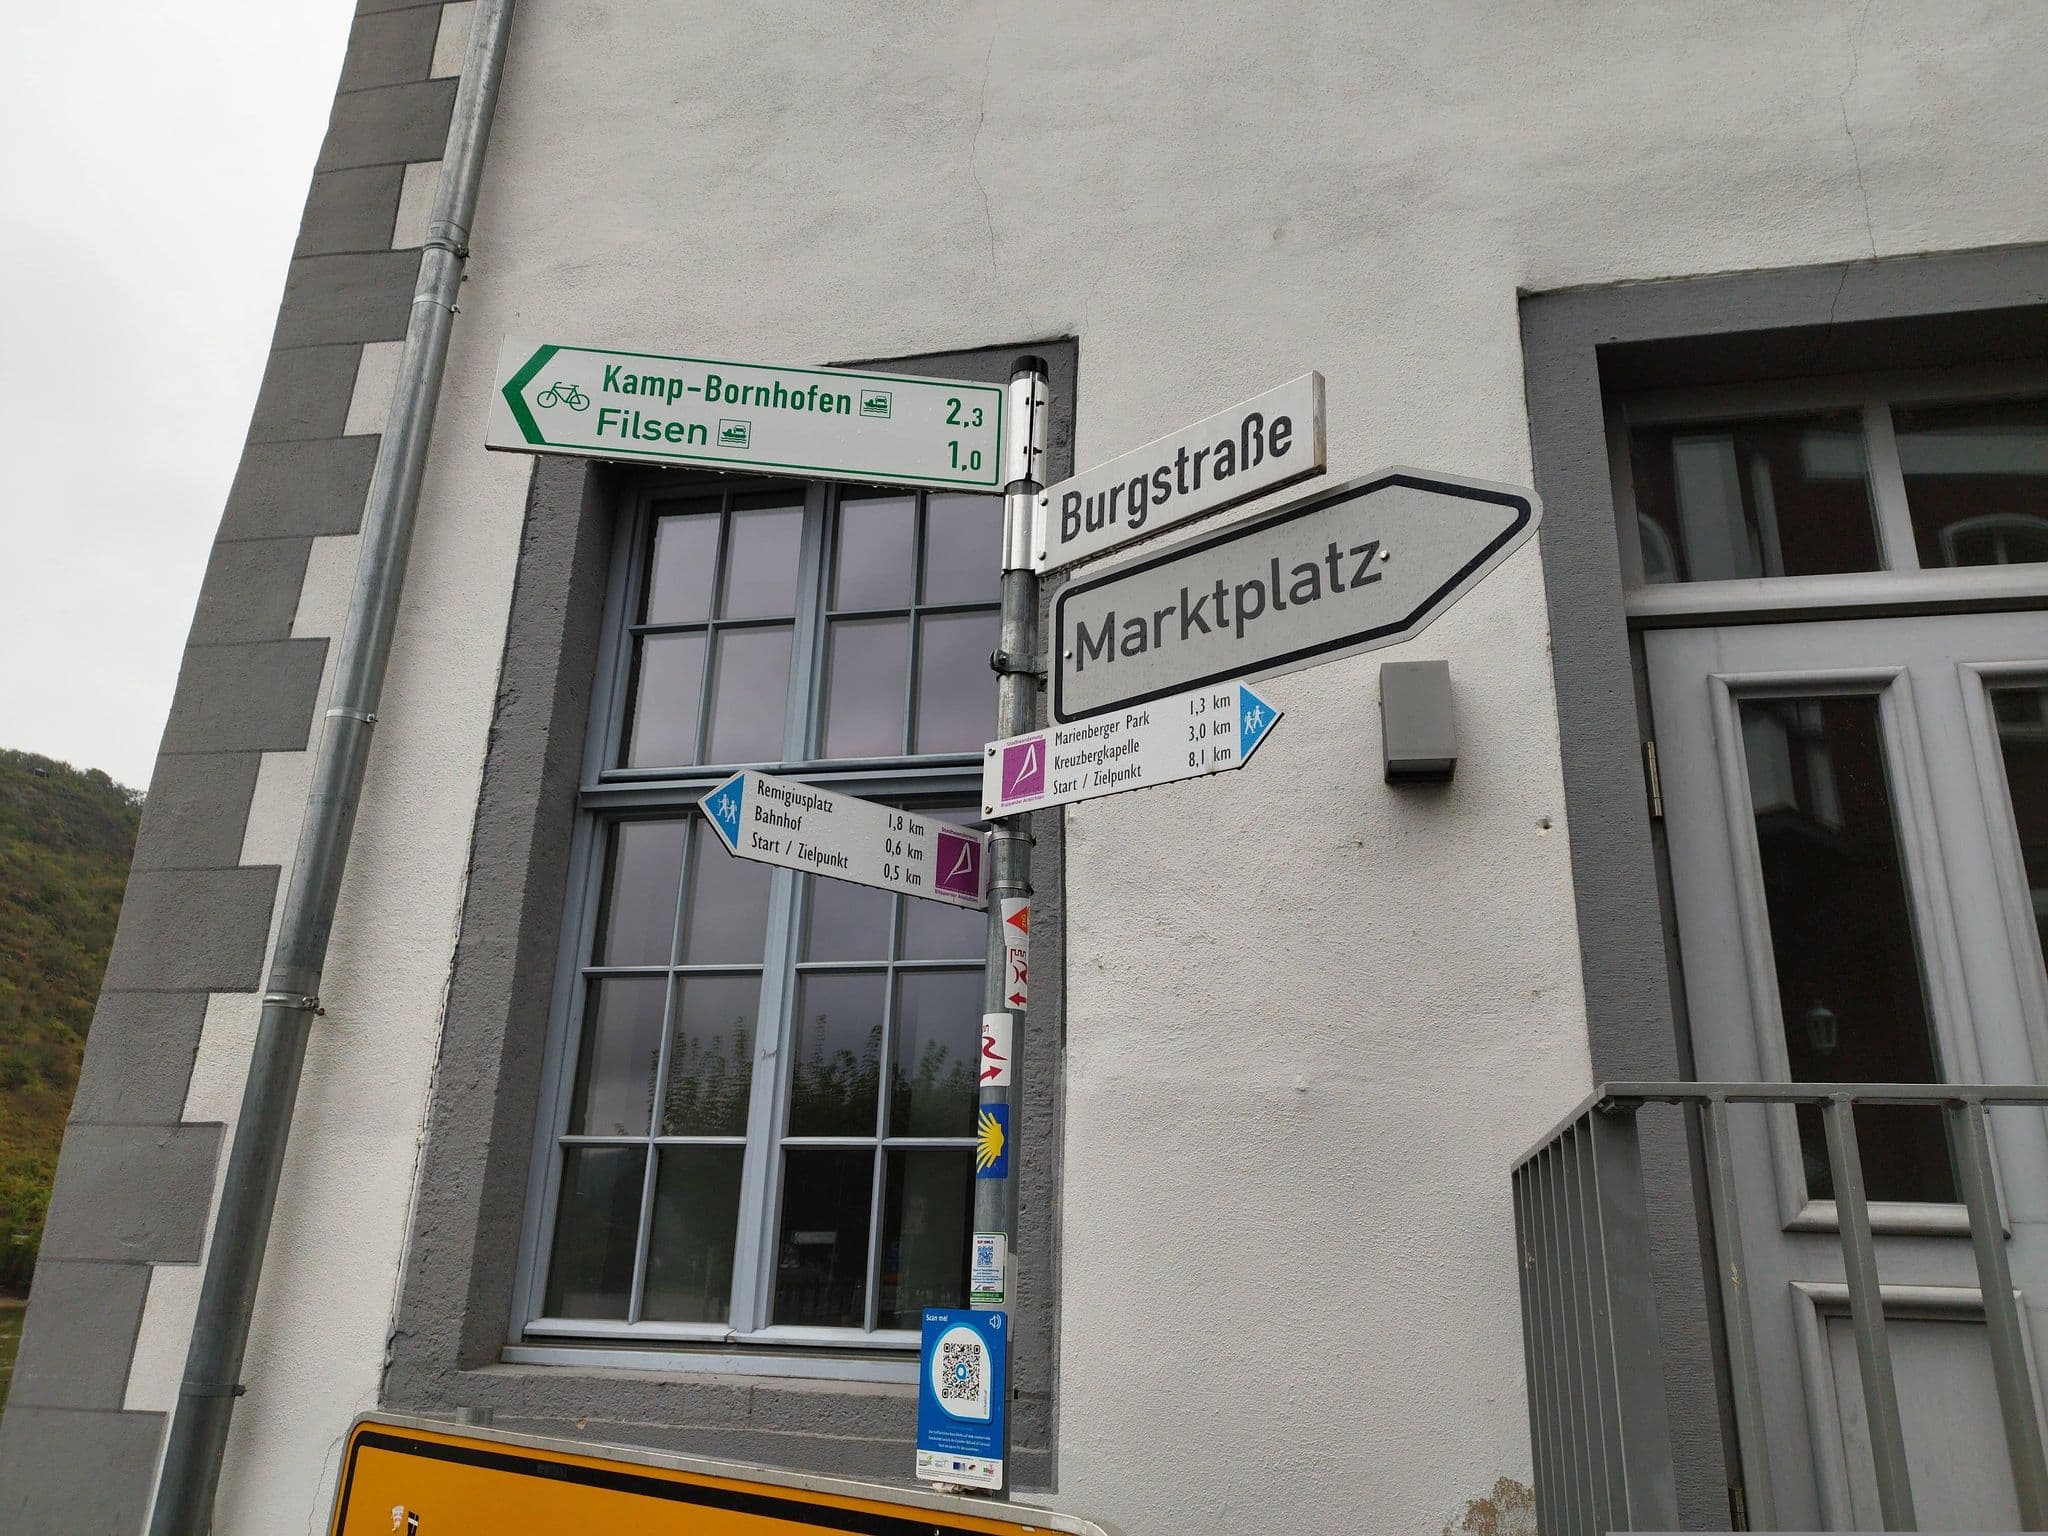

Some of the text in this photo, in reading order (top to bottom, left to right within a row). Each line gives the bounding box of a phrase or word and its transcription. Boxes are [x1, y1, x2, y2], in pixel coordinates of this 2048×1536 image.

[601, 364, 852, 415] Kamp-Bornhofen
[596, 407, 709, 446] Filsen
[945, 397, 984, 428] 2,3
[947, 440, 982, 472] 1,0
[1060, 411, 1294, 544] Burgstraße
[1074, 539, 1382, 672] Marktplatz
[1189, 694, 1231, 717] 1,3 km
[1054, 710, 1150, 747] Marienberger Park
[1188, 720, 1232, 744] 3,0 km
[1054, 739, 1140, 771] Kreuzbergkapelle
[1188, 746, 1232, 769] 8,1 km
[1052, 763, 1142, 796] Start / Zielpunkt
[756, 779, 834, 814] Remigiusplatz
[754, 805, 802, 832] Bahnhof
[888, 813, 925, 837] 1,8 km
[751, 831, 849, 869] Start / Zielpunkt
[885, 837, 923, 862] 0,6 km
[883, 862, 922, 886] 0,5 km
[926, 1313, 938, 1322] Scan
